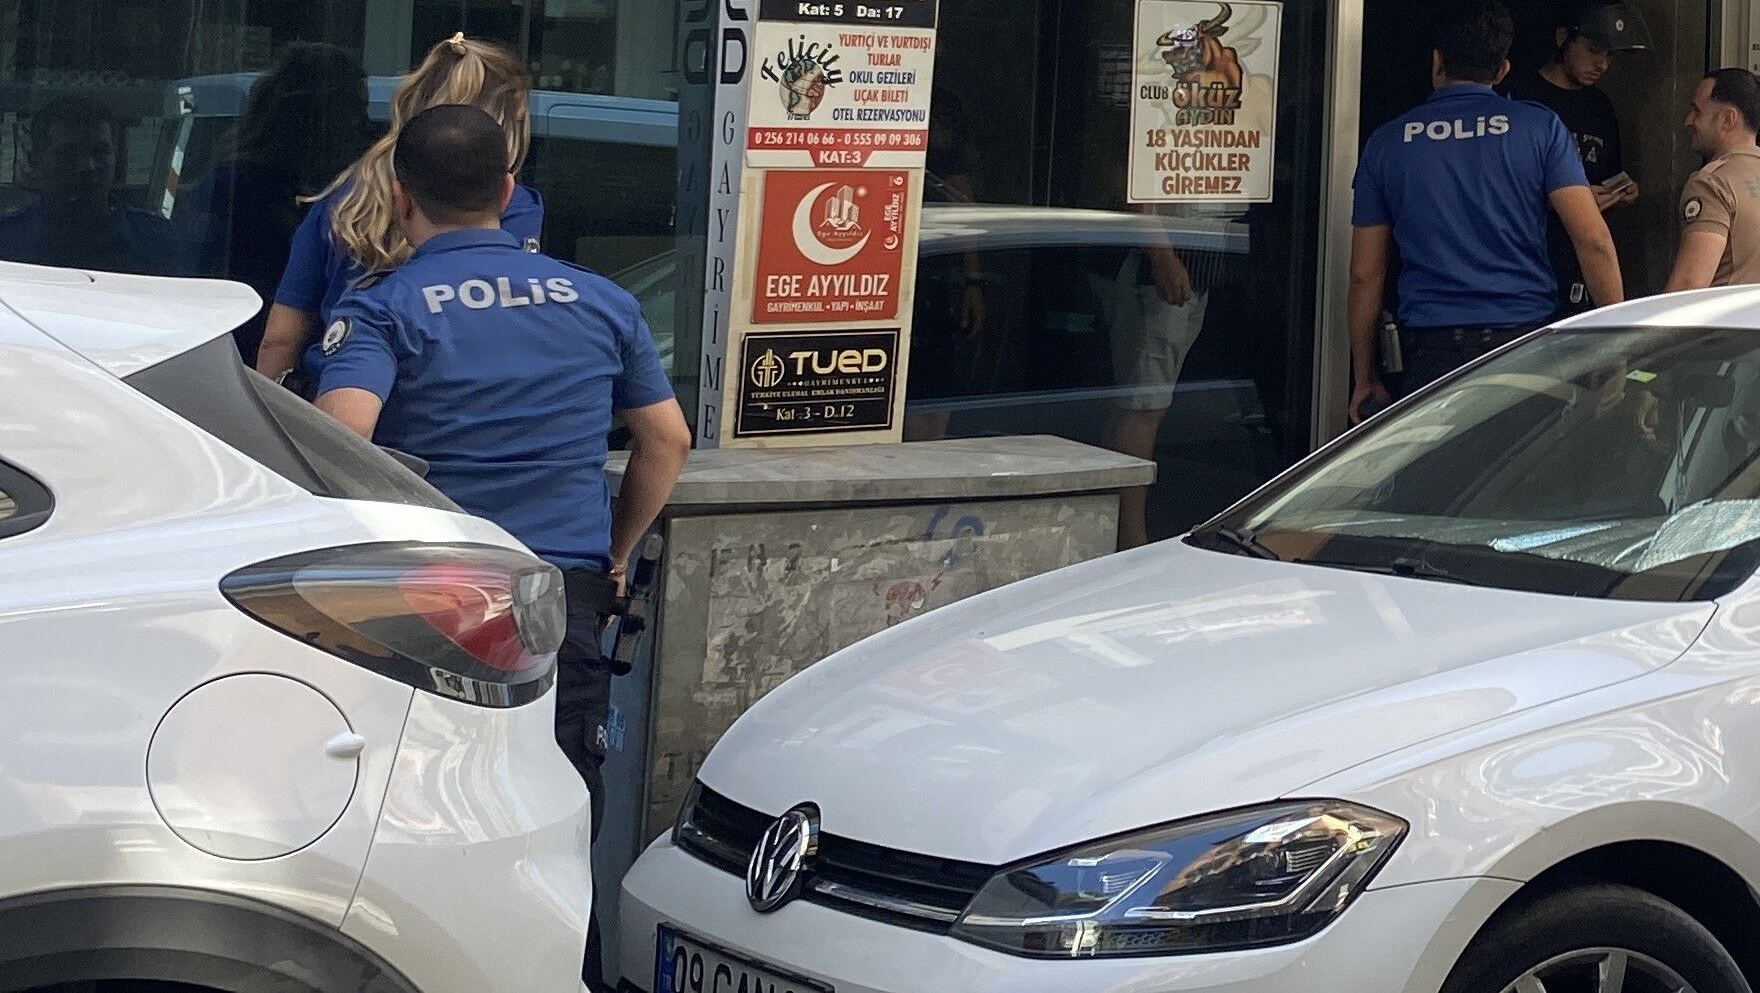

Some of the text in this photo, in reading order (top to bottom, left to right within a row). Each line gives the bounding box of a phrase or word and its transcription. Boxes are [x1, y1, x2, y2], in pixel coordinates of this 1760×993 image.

[799, 2, 904, 19] Kat: 5 Da: 17
[877, 35, 890, 48] VE
[760, 34, 844, 88] Felicity
[867, 53, 902, 67] TURLAR
[849, 67, 916, 84] OKUL GEZİLERİ
[854, 89, 879, 107] UÇAK
[1140, 85, 1169, 101] CLUB
[832, 108, 926, 122] OTEL REZERVASYONU
[764, 132, 783, 145] 256
[785, 132, 804, 145] 214
[807, 133, 820, 145] 06
[822, 133, 835, 145] 66
[853, 133, 872, 145] 555
[874, 134, 886, 145] 09
[889, 134, 901, 145] 09
[903, 134, 921, 145] 306
[1146, 129, 1261, 150] 18 YAŞINDAN
[819, 150, 862, 164] KAT:3
[1155, 149, 1251, 173] KÜÇÜKLER
[1162, 173, 1242, 195] GİREMEZ
[766, 274, 890, 297] EGE AYYILDIZ
